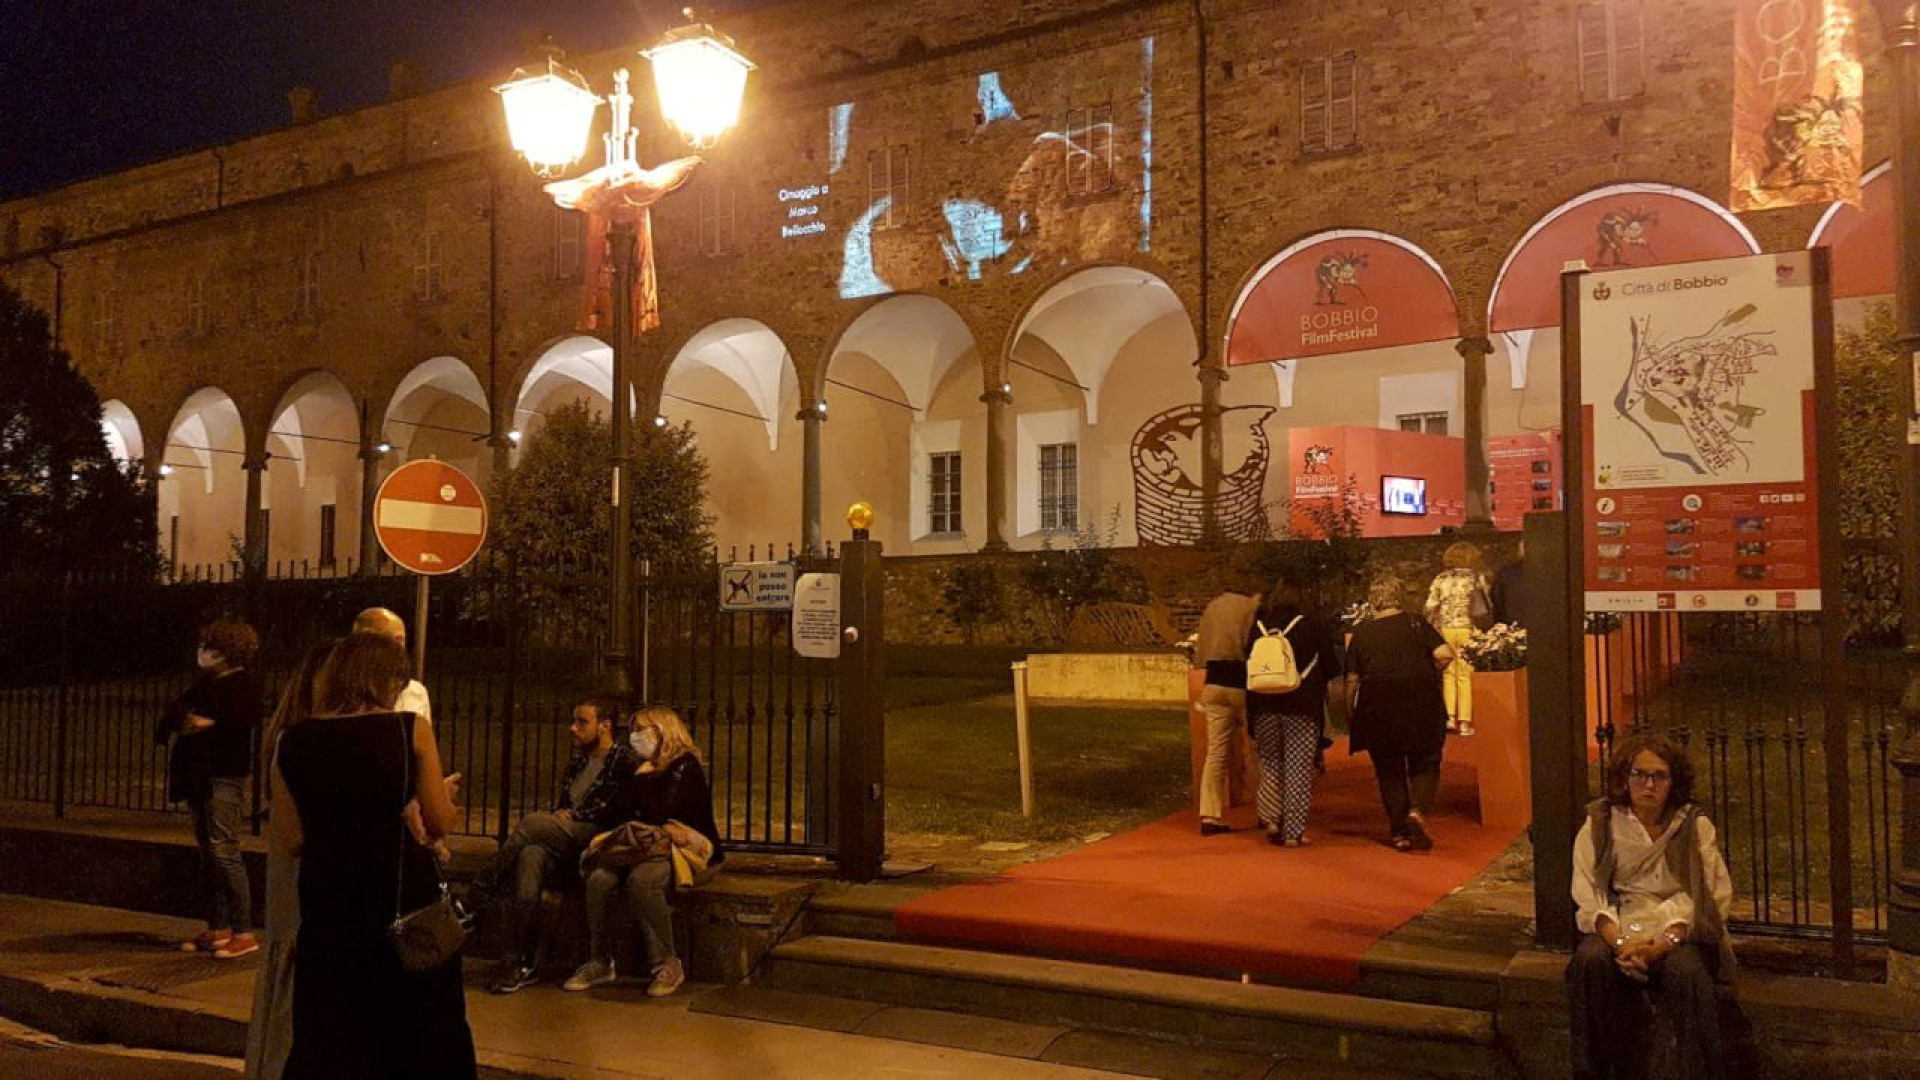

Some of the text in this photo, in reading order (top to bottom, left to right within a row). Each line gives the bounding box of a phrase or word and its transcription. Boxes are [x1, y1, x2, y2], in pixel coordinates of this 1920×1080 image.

[779, 184, 829, 201] Omaggio a
[789, 205, 818, 218] Marco
[782, 220, 826, 238] Bellocchio
[1621, 275, 1729, 296] Città di Bobbio
[1301, 305, 1378, 331] BOBBIO
[1301, 322, 1378, 346] FilmFestival
